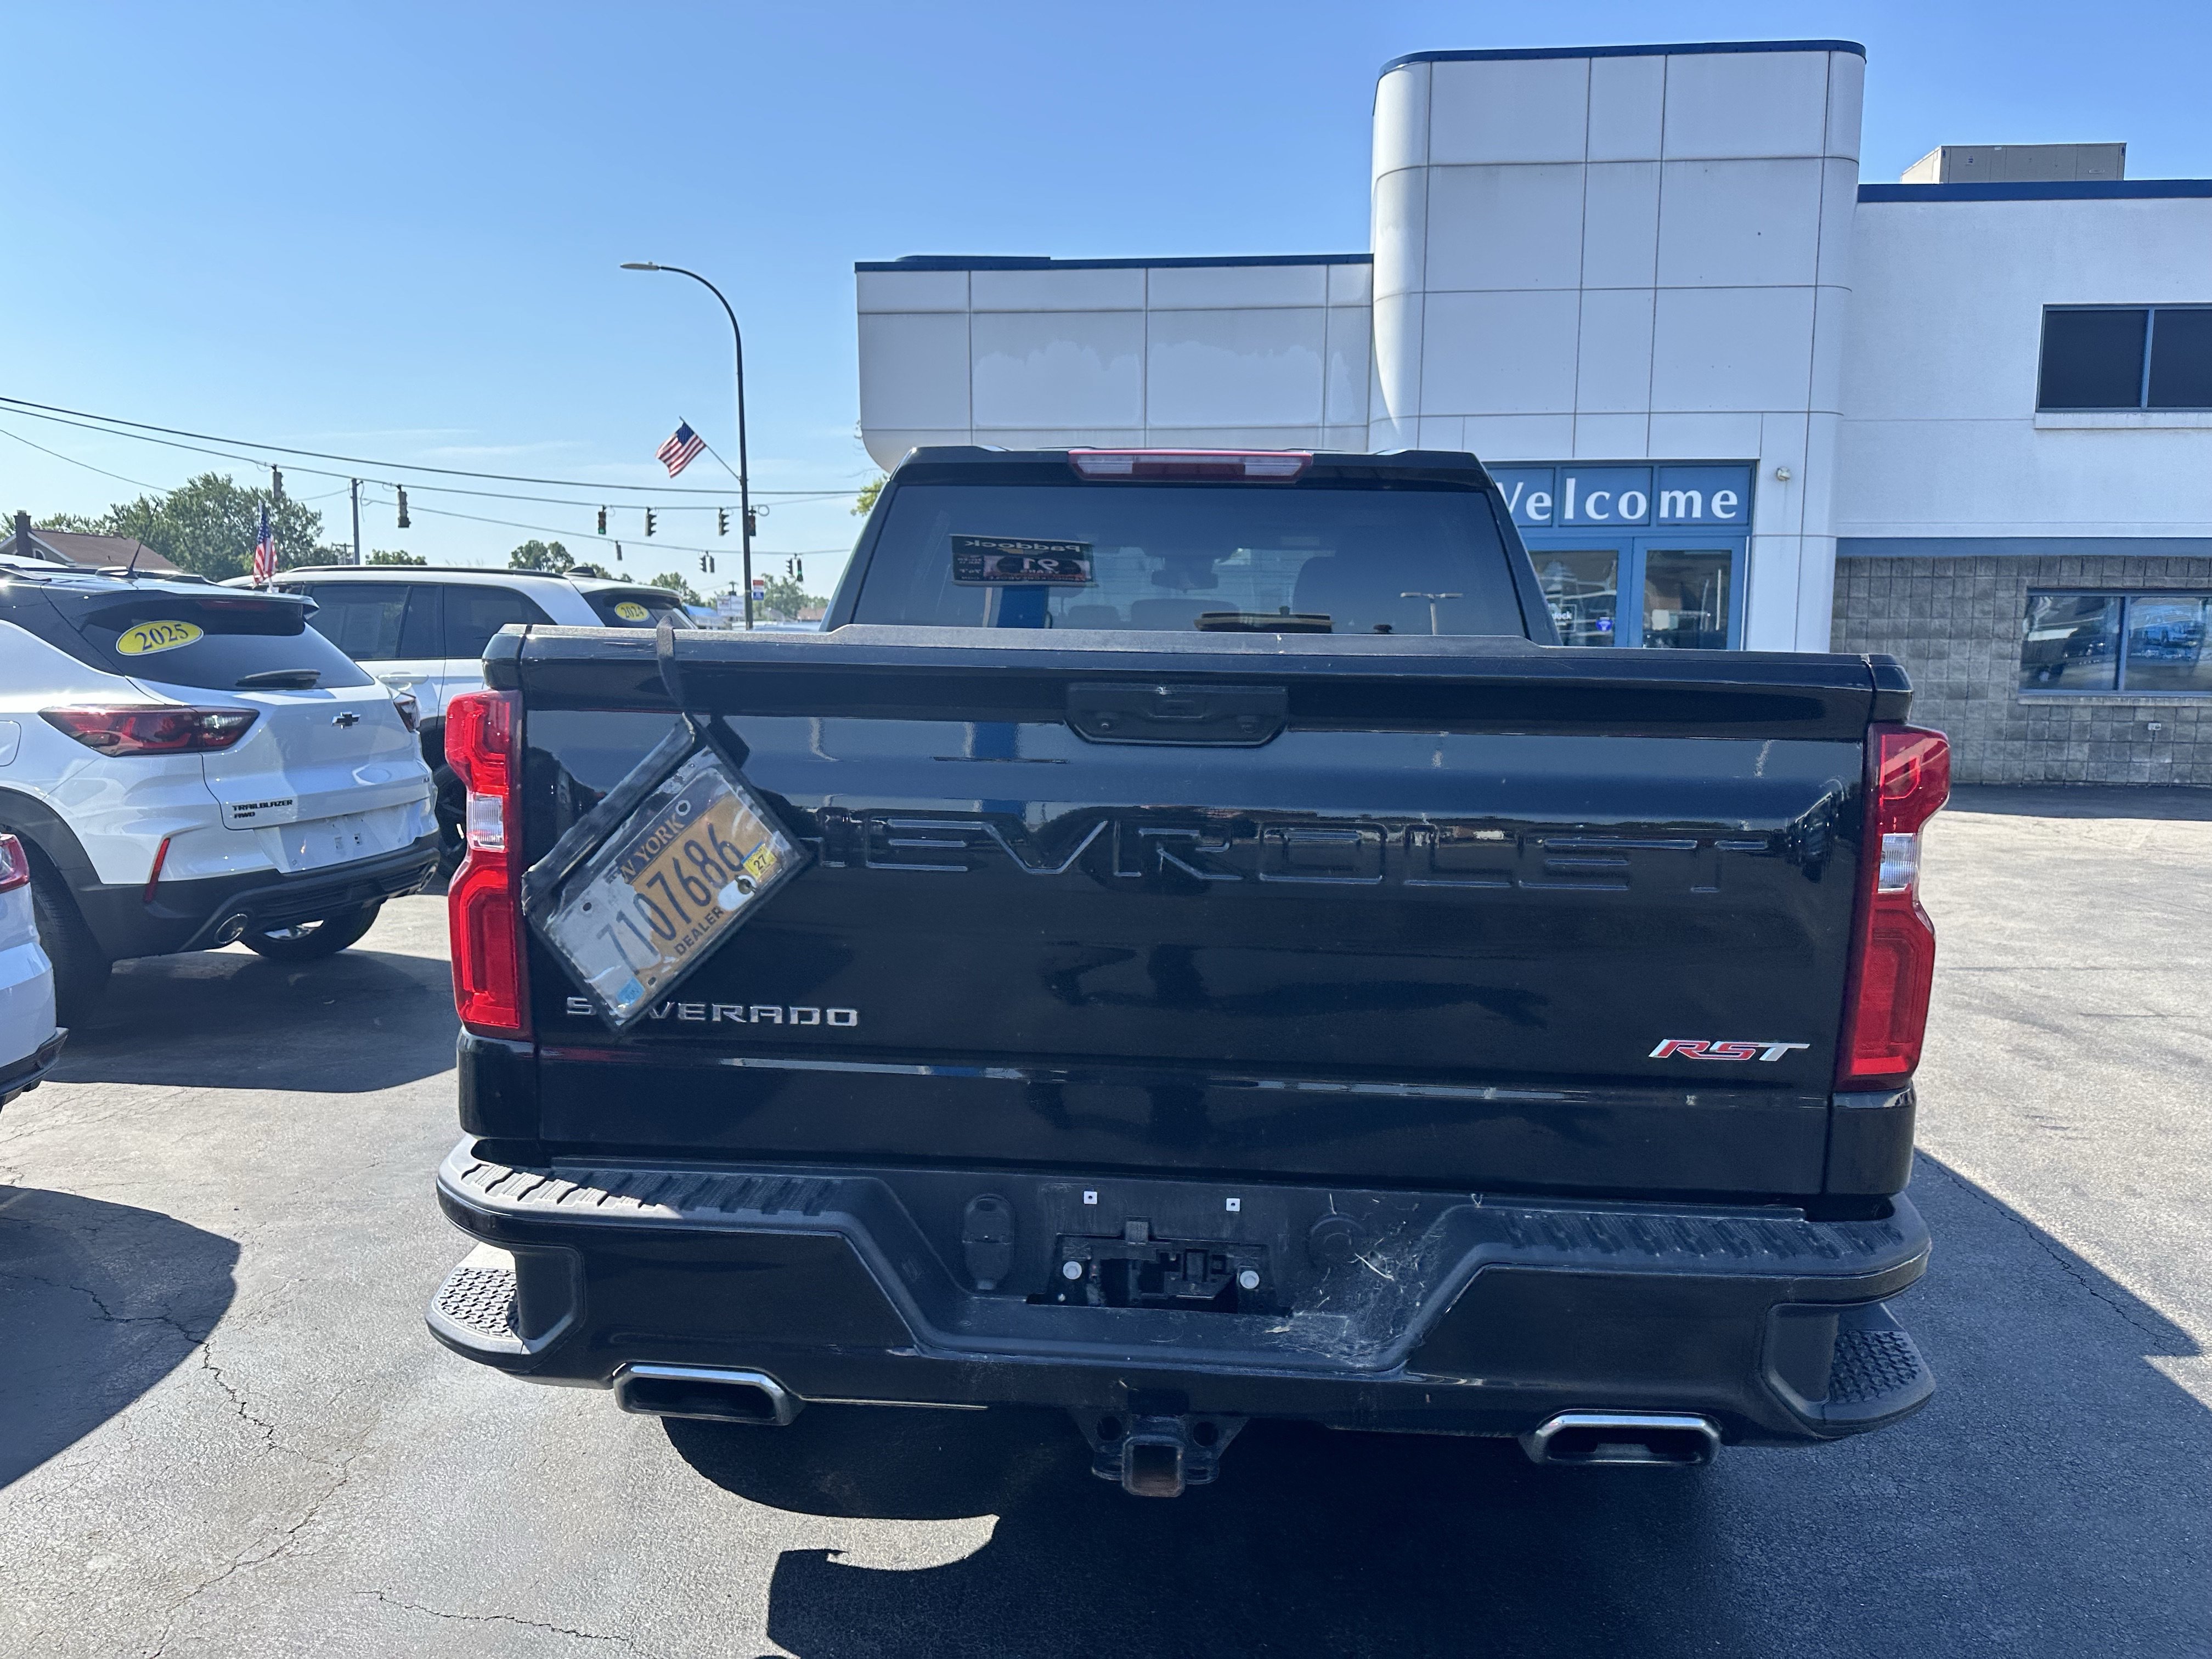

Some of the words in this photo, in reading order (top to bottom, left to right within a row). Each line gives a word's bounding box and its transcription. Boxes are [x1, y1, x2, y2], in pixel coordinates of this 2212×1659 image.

[620, 605, 644, 618] 2024
[134, 624, 189, 651] 2025
[232, 799, 293, 811] TRAILBLAZER
[634, 812, 686, 862] YORK
[753, 854, 767, 871] 27
[596, 822, 745, 975] 7107686
[674, 905, 725, 956] DEALER
[567, 996, 858, 1027] SVERADO
[1648, 1039, 1810, 1062] RST
